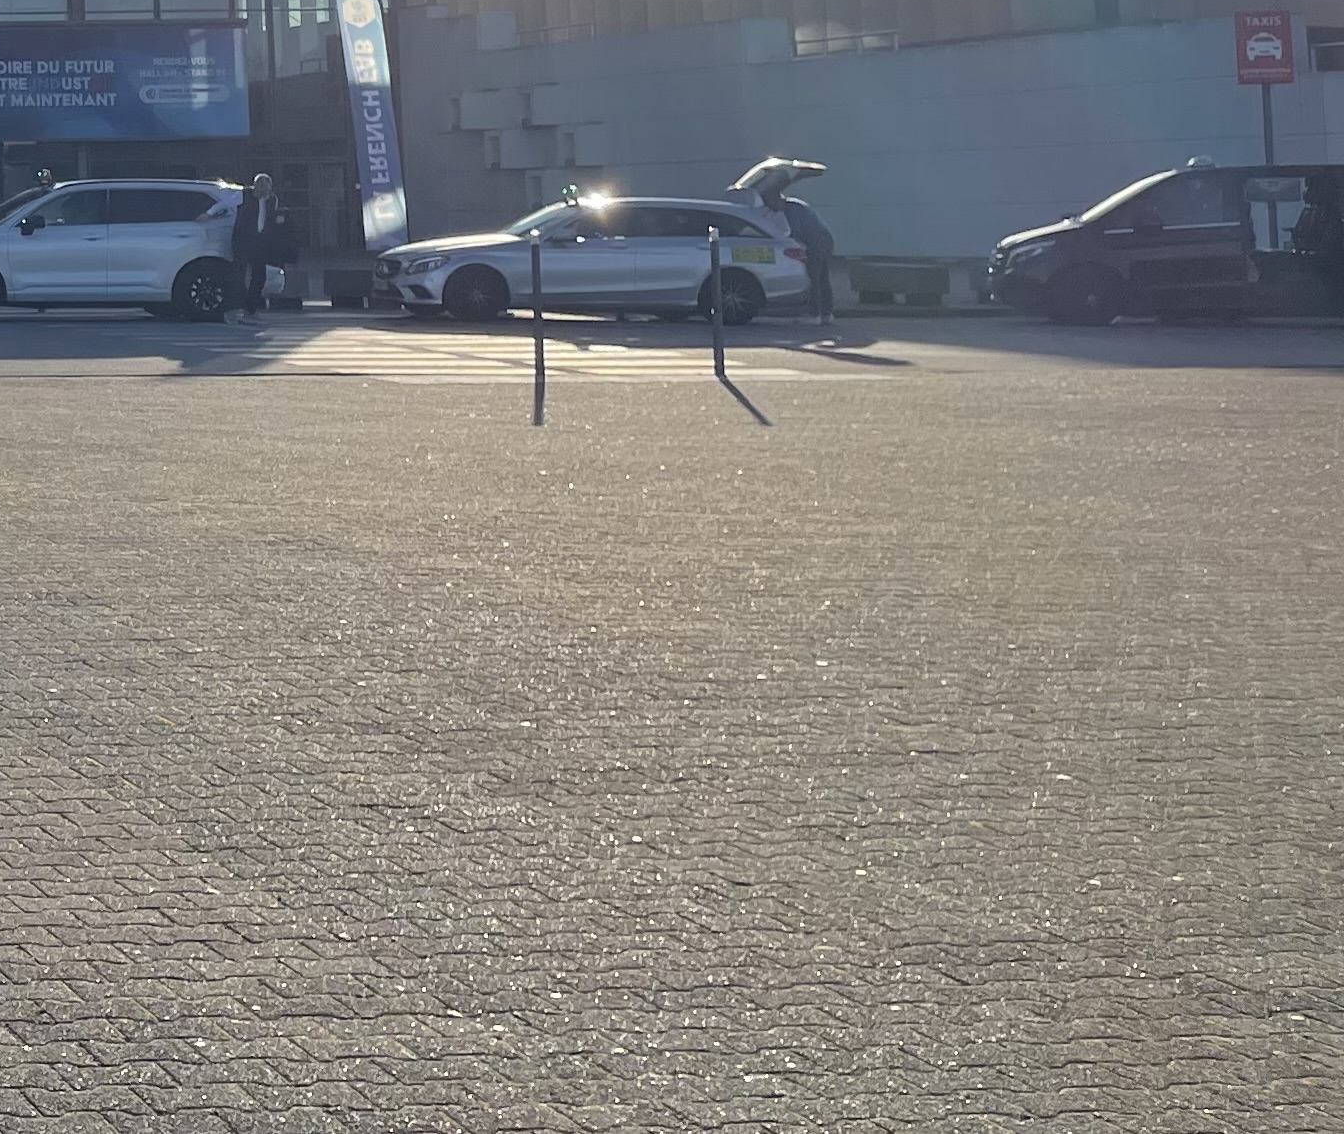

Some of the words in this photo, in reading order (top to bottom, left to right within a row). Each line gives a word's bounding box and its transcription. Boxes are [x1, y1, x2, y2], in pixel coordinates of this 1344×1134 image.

[1244, 15, 1282, 26] TAXIS
[37, 60, 60, 74] DU
[65, 60, 114, 74] FUTUR
[11, 92, 118, 108] MAINTENANT
